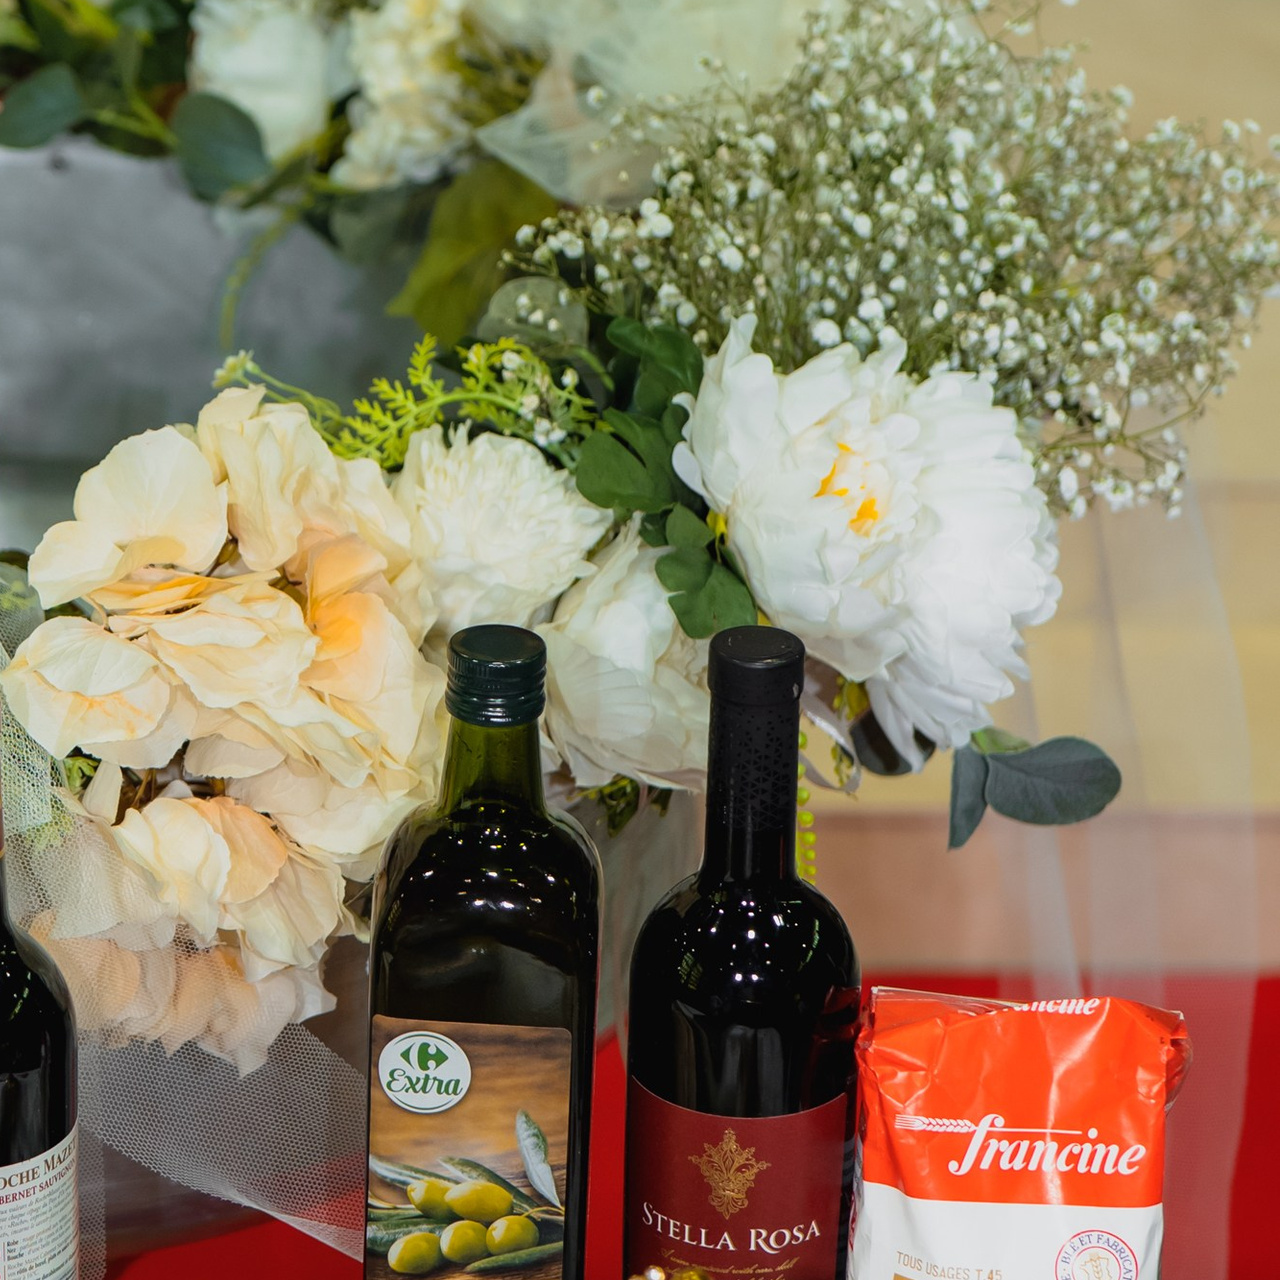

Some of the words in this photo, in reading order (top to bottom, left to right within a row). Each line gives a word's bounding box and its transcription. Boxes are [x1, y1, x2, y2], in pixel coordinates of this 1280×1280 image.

[386, 1068, 463, 1096] Extra
[948, 1113, 1147, 1176] francine
[642, 1202, 738, 1251] STELLA
[749, 1220, 821, 1254] ROSA
[897, 1250, 923, 1272] TOUS
[926, 1262, 970, 1280] USAGES
